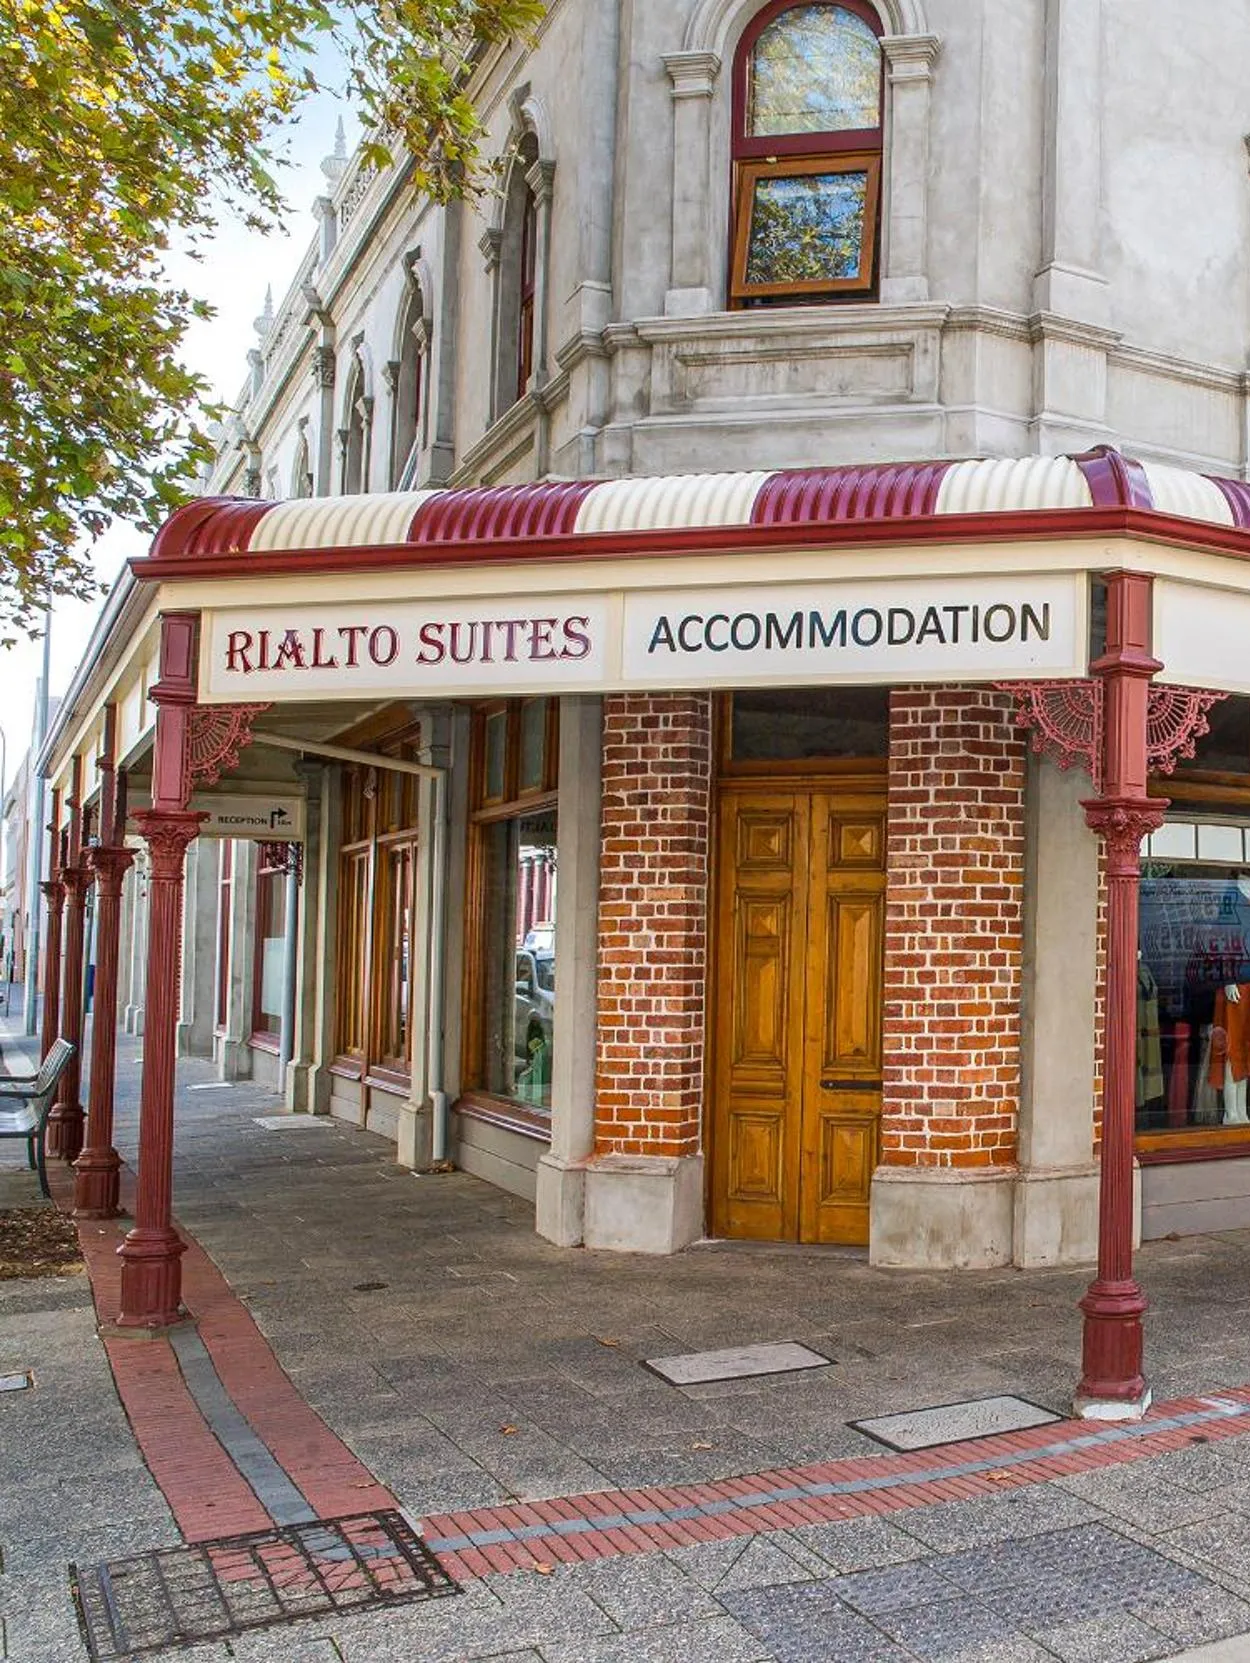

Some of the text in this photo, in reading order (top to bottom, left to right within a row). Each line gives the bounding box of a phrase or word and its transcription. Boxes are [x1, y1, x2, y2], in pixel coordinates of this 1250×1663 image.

[226, 616, 594, 674] RIALTO SUITES
[647, 602, 1051, 654] ACCOMMODATION
[217, 815, 268, 826] RECEPTION
